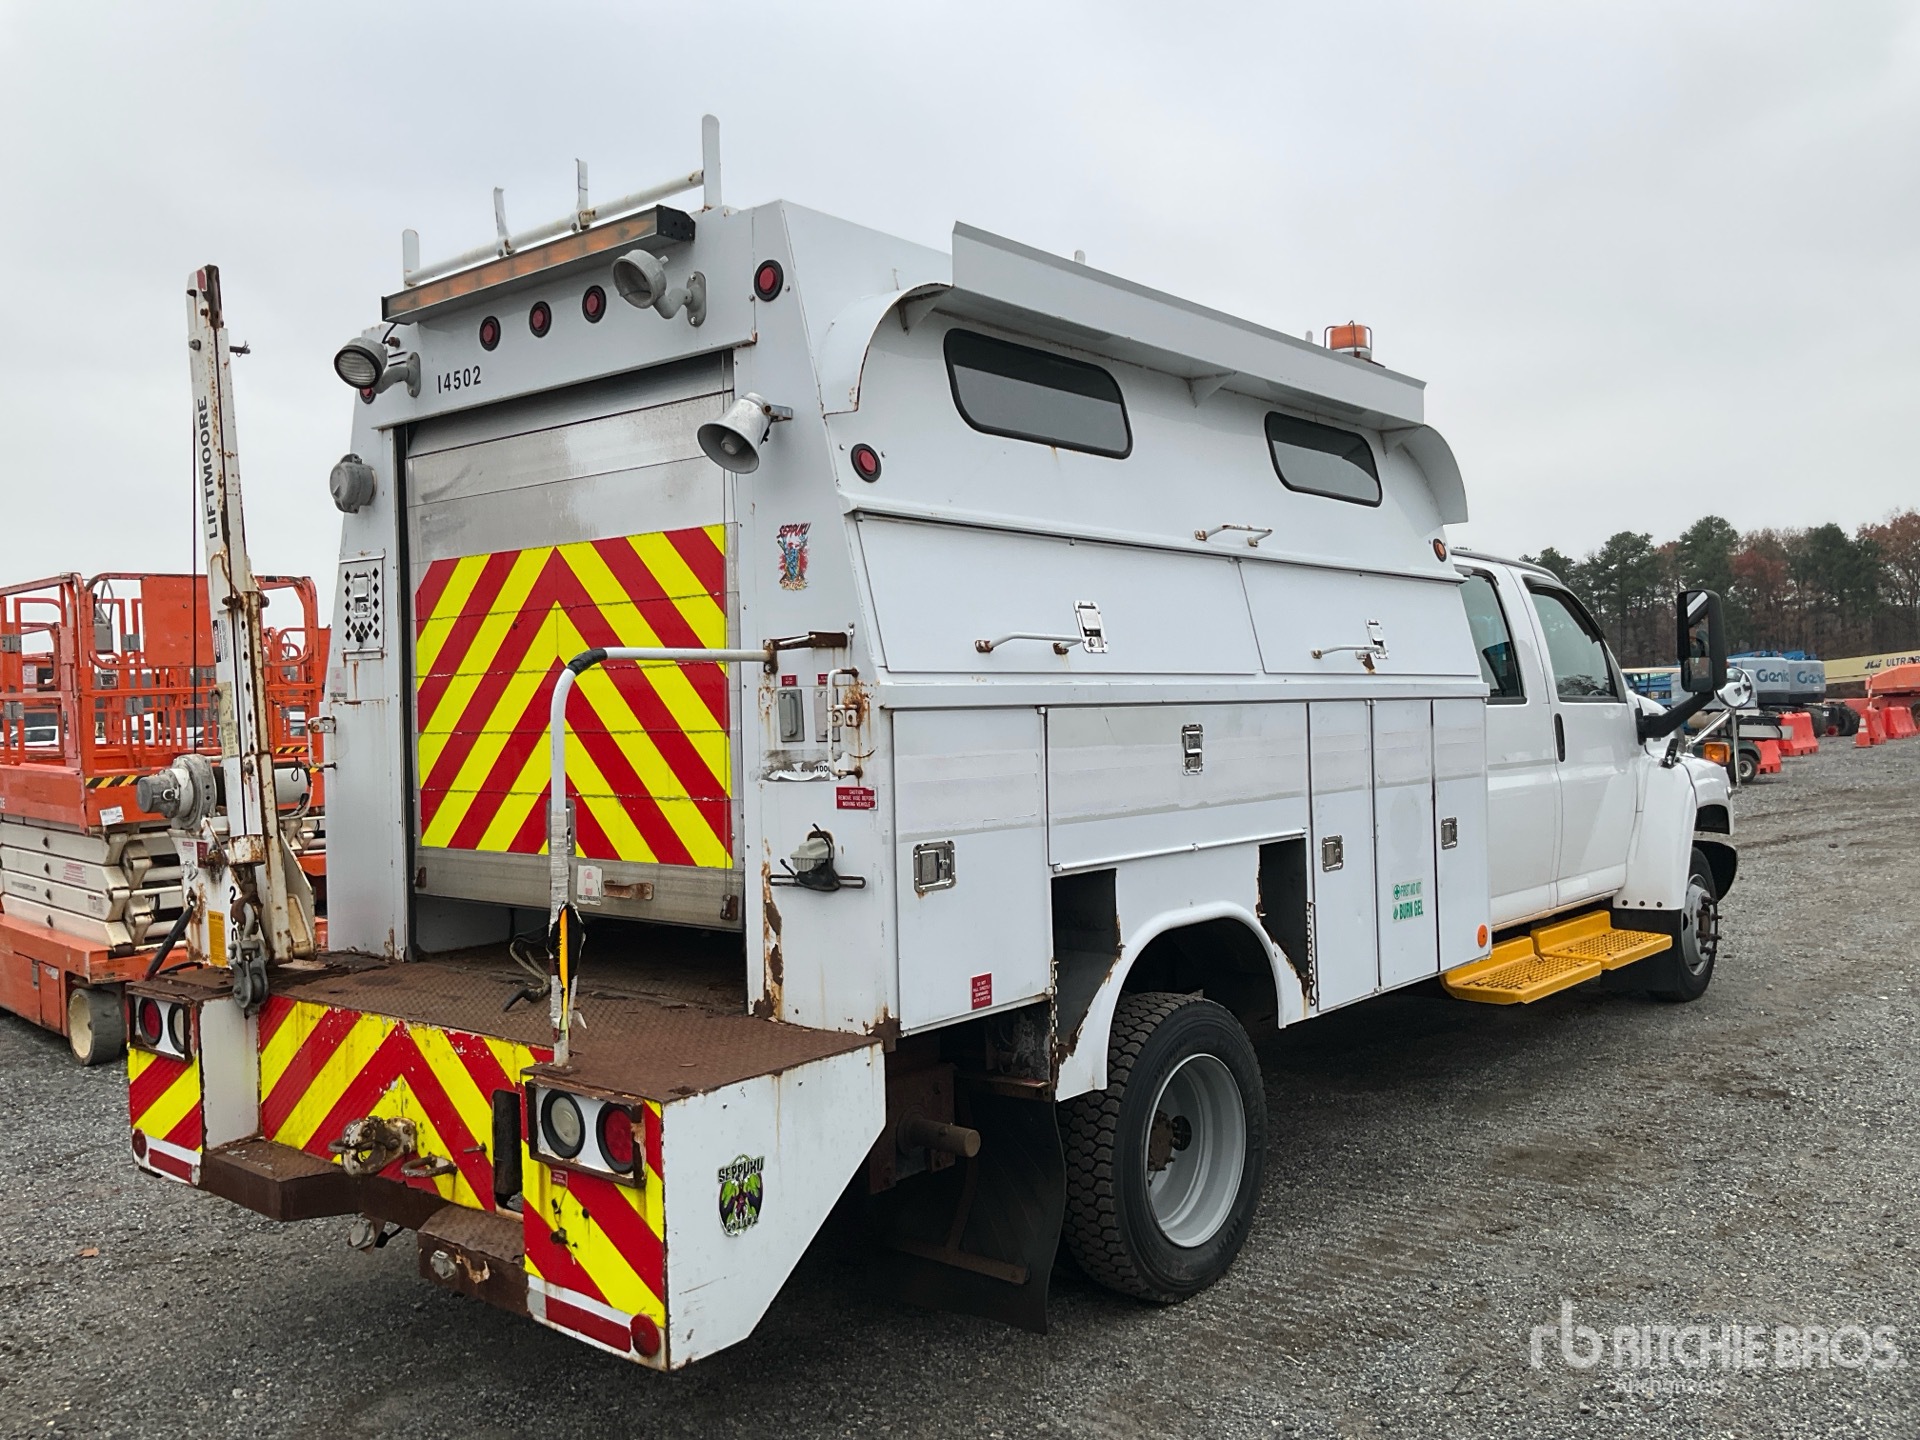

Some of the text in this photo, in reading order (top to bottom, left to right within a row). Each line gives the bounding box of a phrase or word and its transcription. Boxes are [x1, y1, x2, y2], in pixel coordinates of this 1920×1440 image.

[437, 365, 482, 394] 14502
[197, 396, 218, 539] LIFTMOORE
[1400, 900, 1424, 920] BURN GEL
[718, 1156, 765, 1183] SEPPUKU
